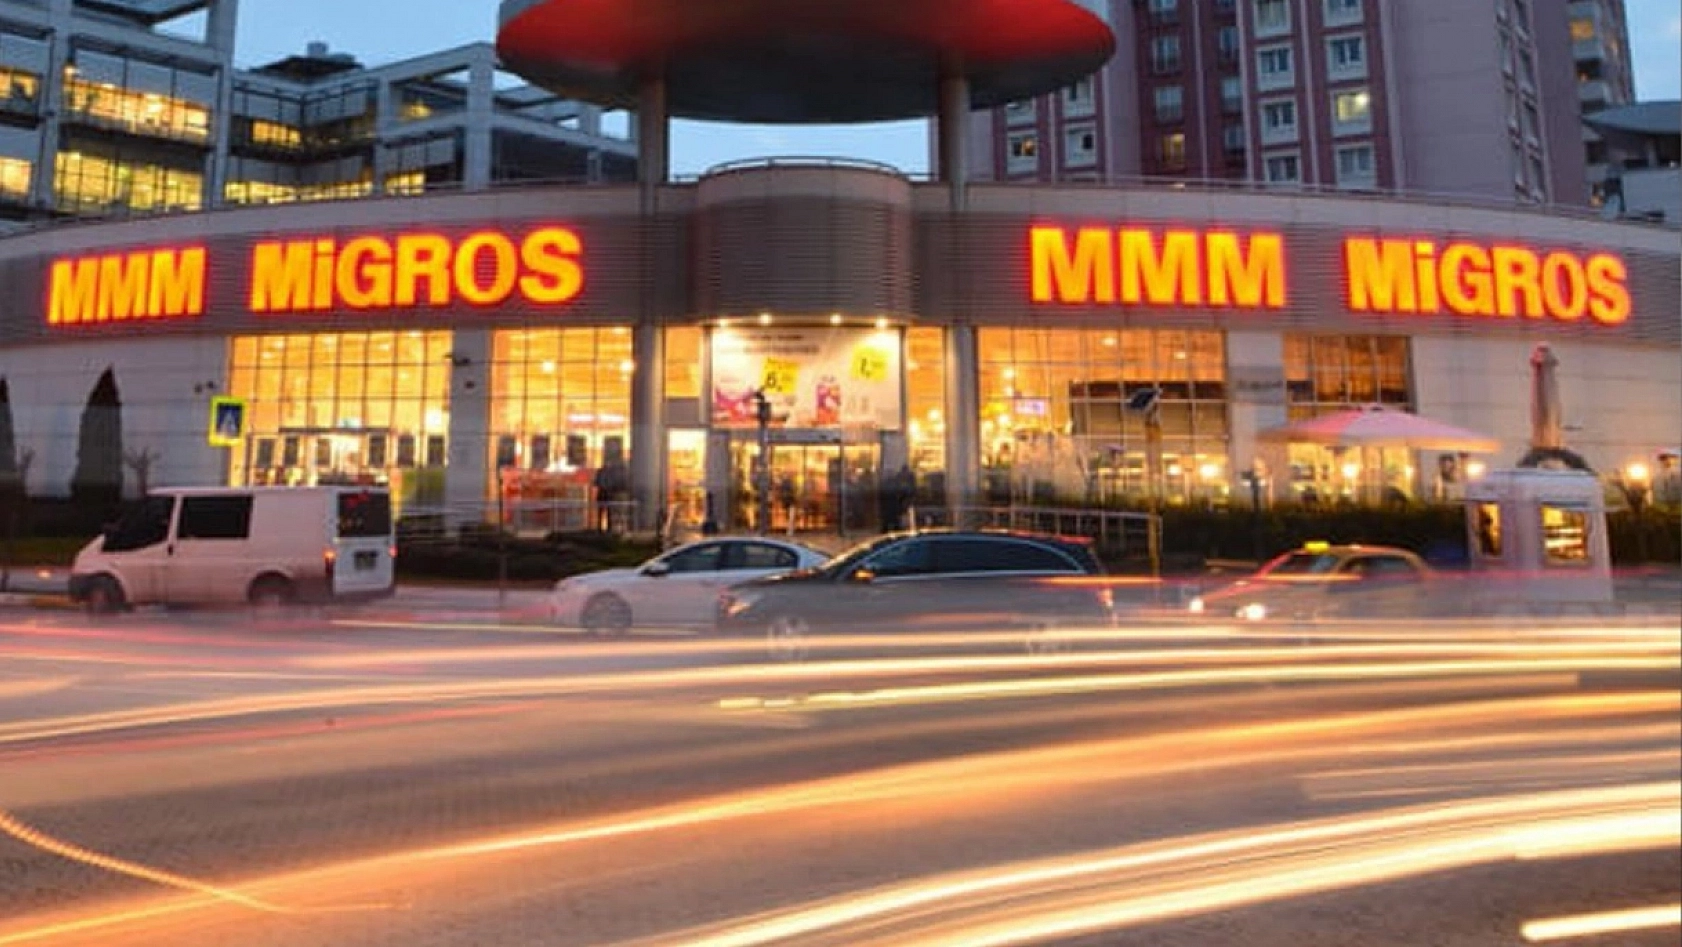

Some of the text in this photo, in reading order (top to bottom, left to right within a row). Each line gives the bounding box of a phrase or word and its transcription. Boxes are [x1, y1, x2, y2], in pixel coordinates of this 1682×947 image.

[47, 227, 583, 324] MMM MiGROS
[1029, 226, 1632, 324] MMM MiGROS
